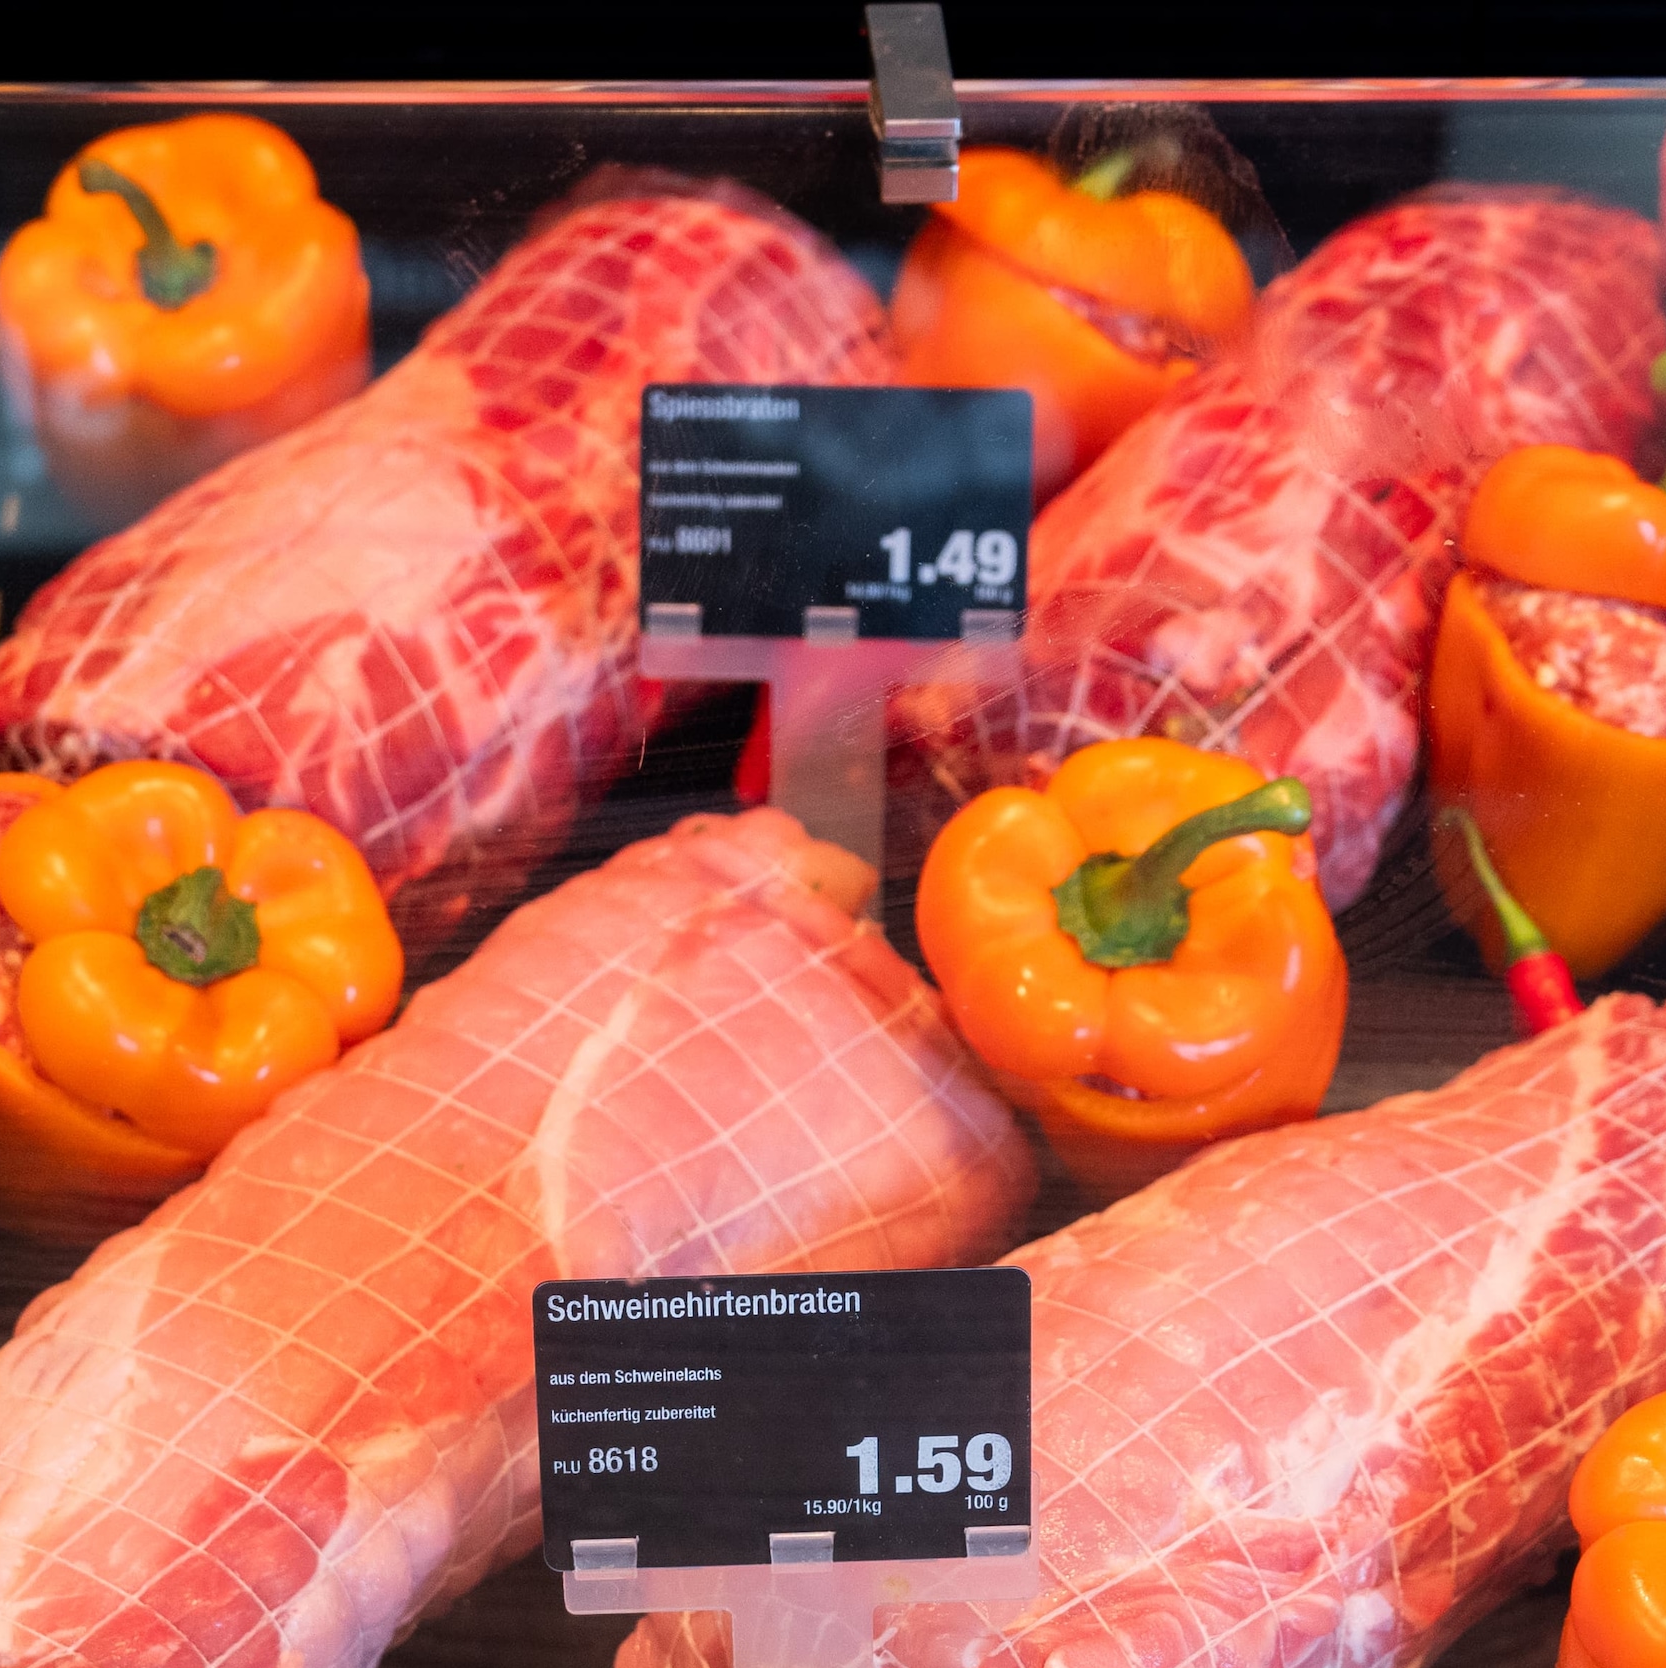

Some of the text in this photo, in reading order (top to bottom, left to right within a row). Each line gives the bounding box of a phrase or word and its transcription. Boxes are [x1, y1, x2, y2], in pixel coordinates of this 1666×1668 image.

[880, 527, 1017, 585] 1.49
[547, 1288, 861, 1322] Schweinehirtenbraten
[549, 1367, 722, 1386] aus dem Schweinelachs
[551, 1404, 716, 1424] küchenfertig zubereitet
[553, 1446, 659, 1475] PLU 8618
[846, 1432, 1013, 1494] 1.59
[803, 1494, 1008, 1517] 15.90/1kg 100 g
